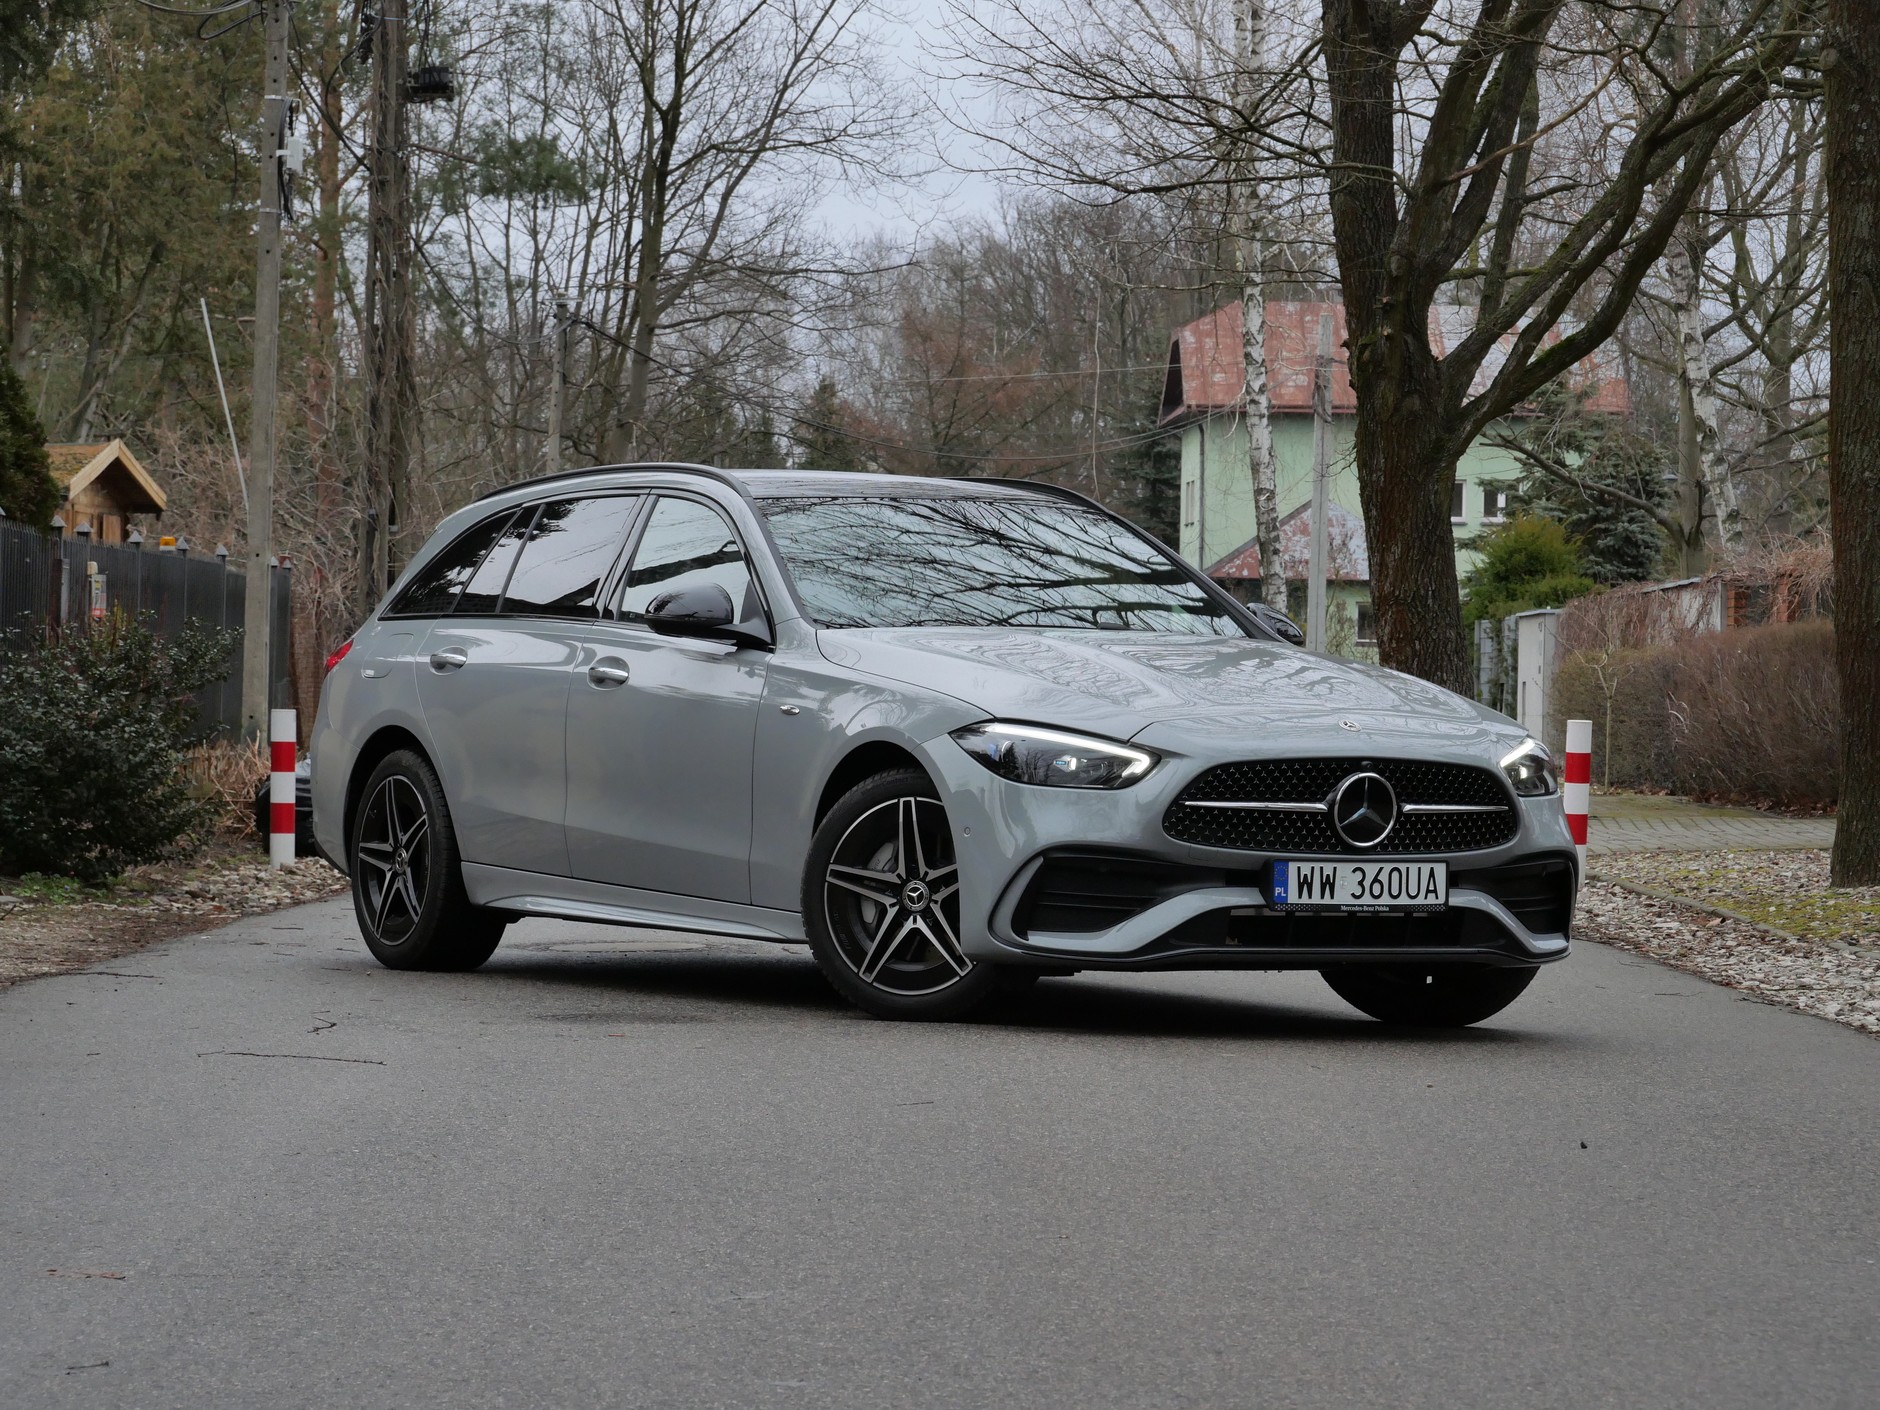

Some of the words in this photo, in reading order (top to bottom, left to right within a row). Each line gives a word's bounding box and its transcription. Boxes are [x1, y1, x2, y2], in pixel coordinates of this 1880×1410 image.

[1275, 887, 1287, 896] PL
[1296, 865, 1338, 900] WW
[1350, 866, 1439, 900] 360UA
